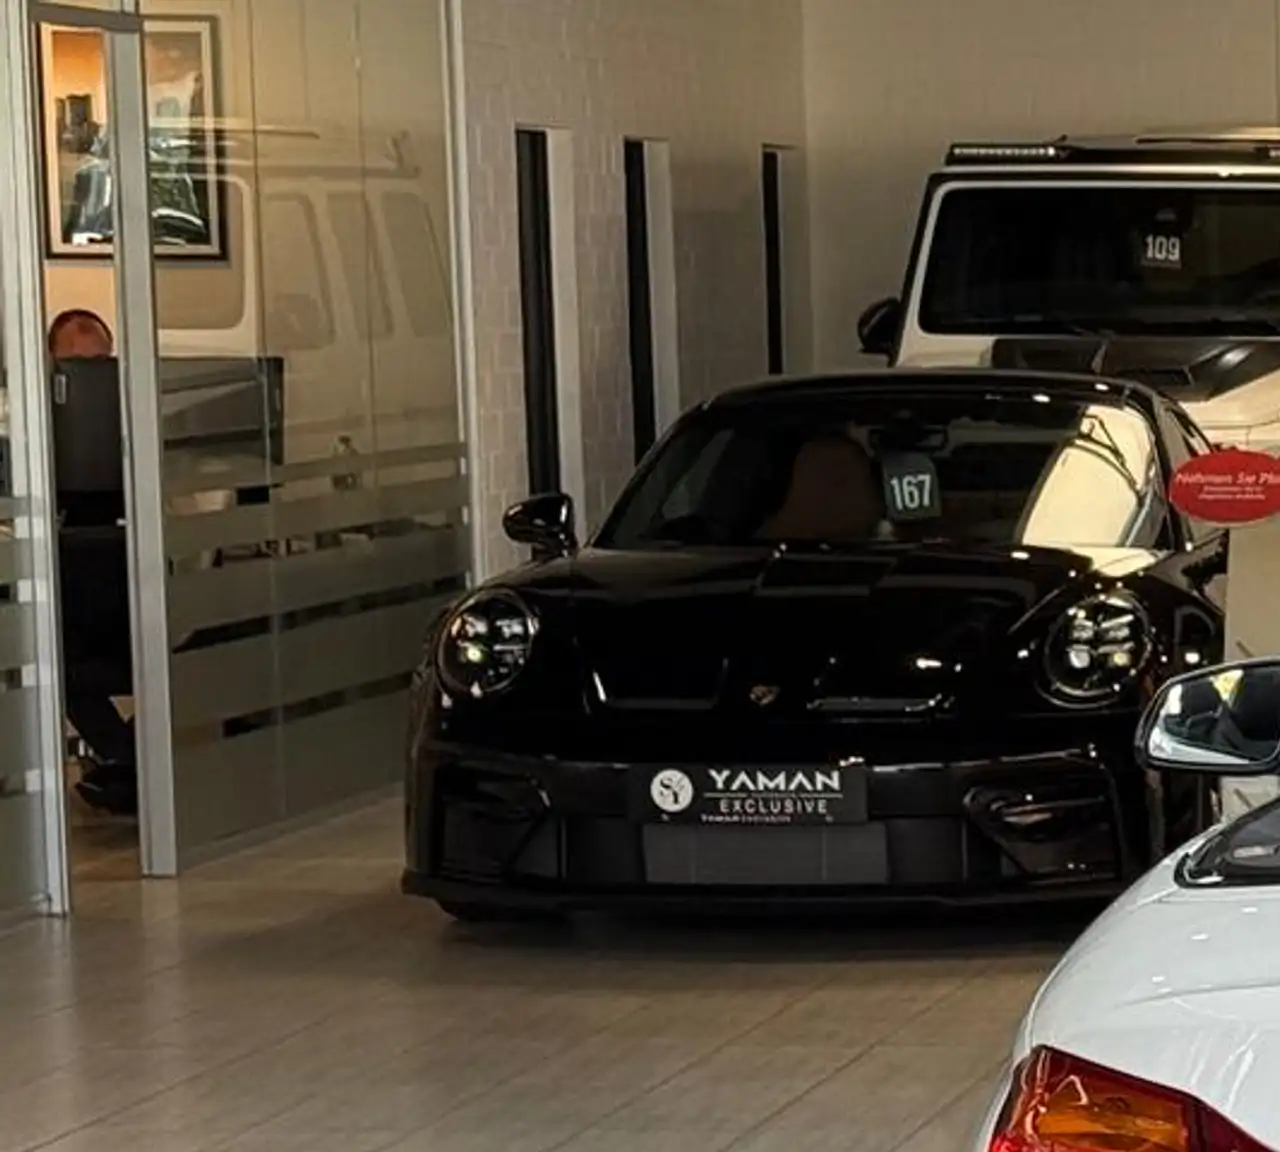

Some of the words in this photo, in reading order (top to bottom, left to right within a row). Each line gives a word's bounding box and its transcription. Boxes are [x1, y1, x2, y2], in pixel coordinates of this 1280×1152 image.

[1144, 233, 1181, 262] 109
[889, 474, 931, 511] 167
[707, 768, 842, 792] YAMAN
[718, 800, 828, 814] EXCLUSIVE
